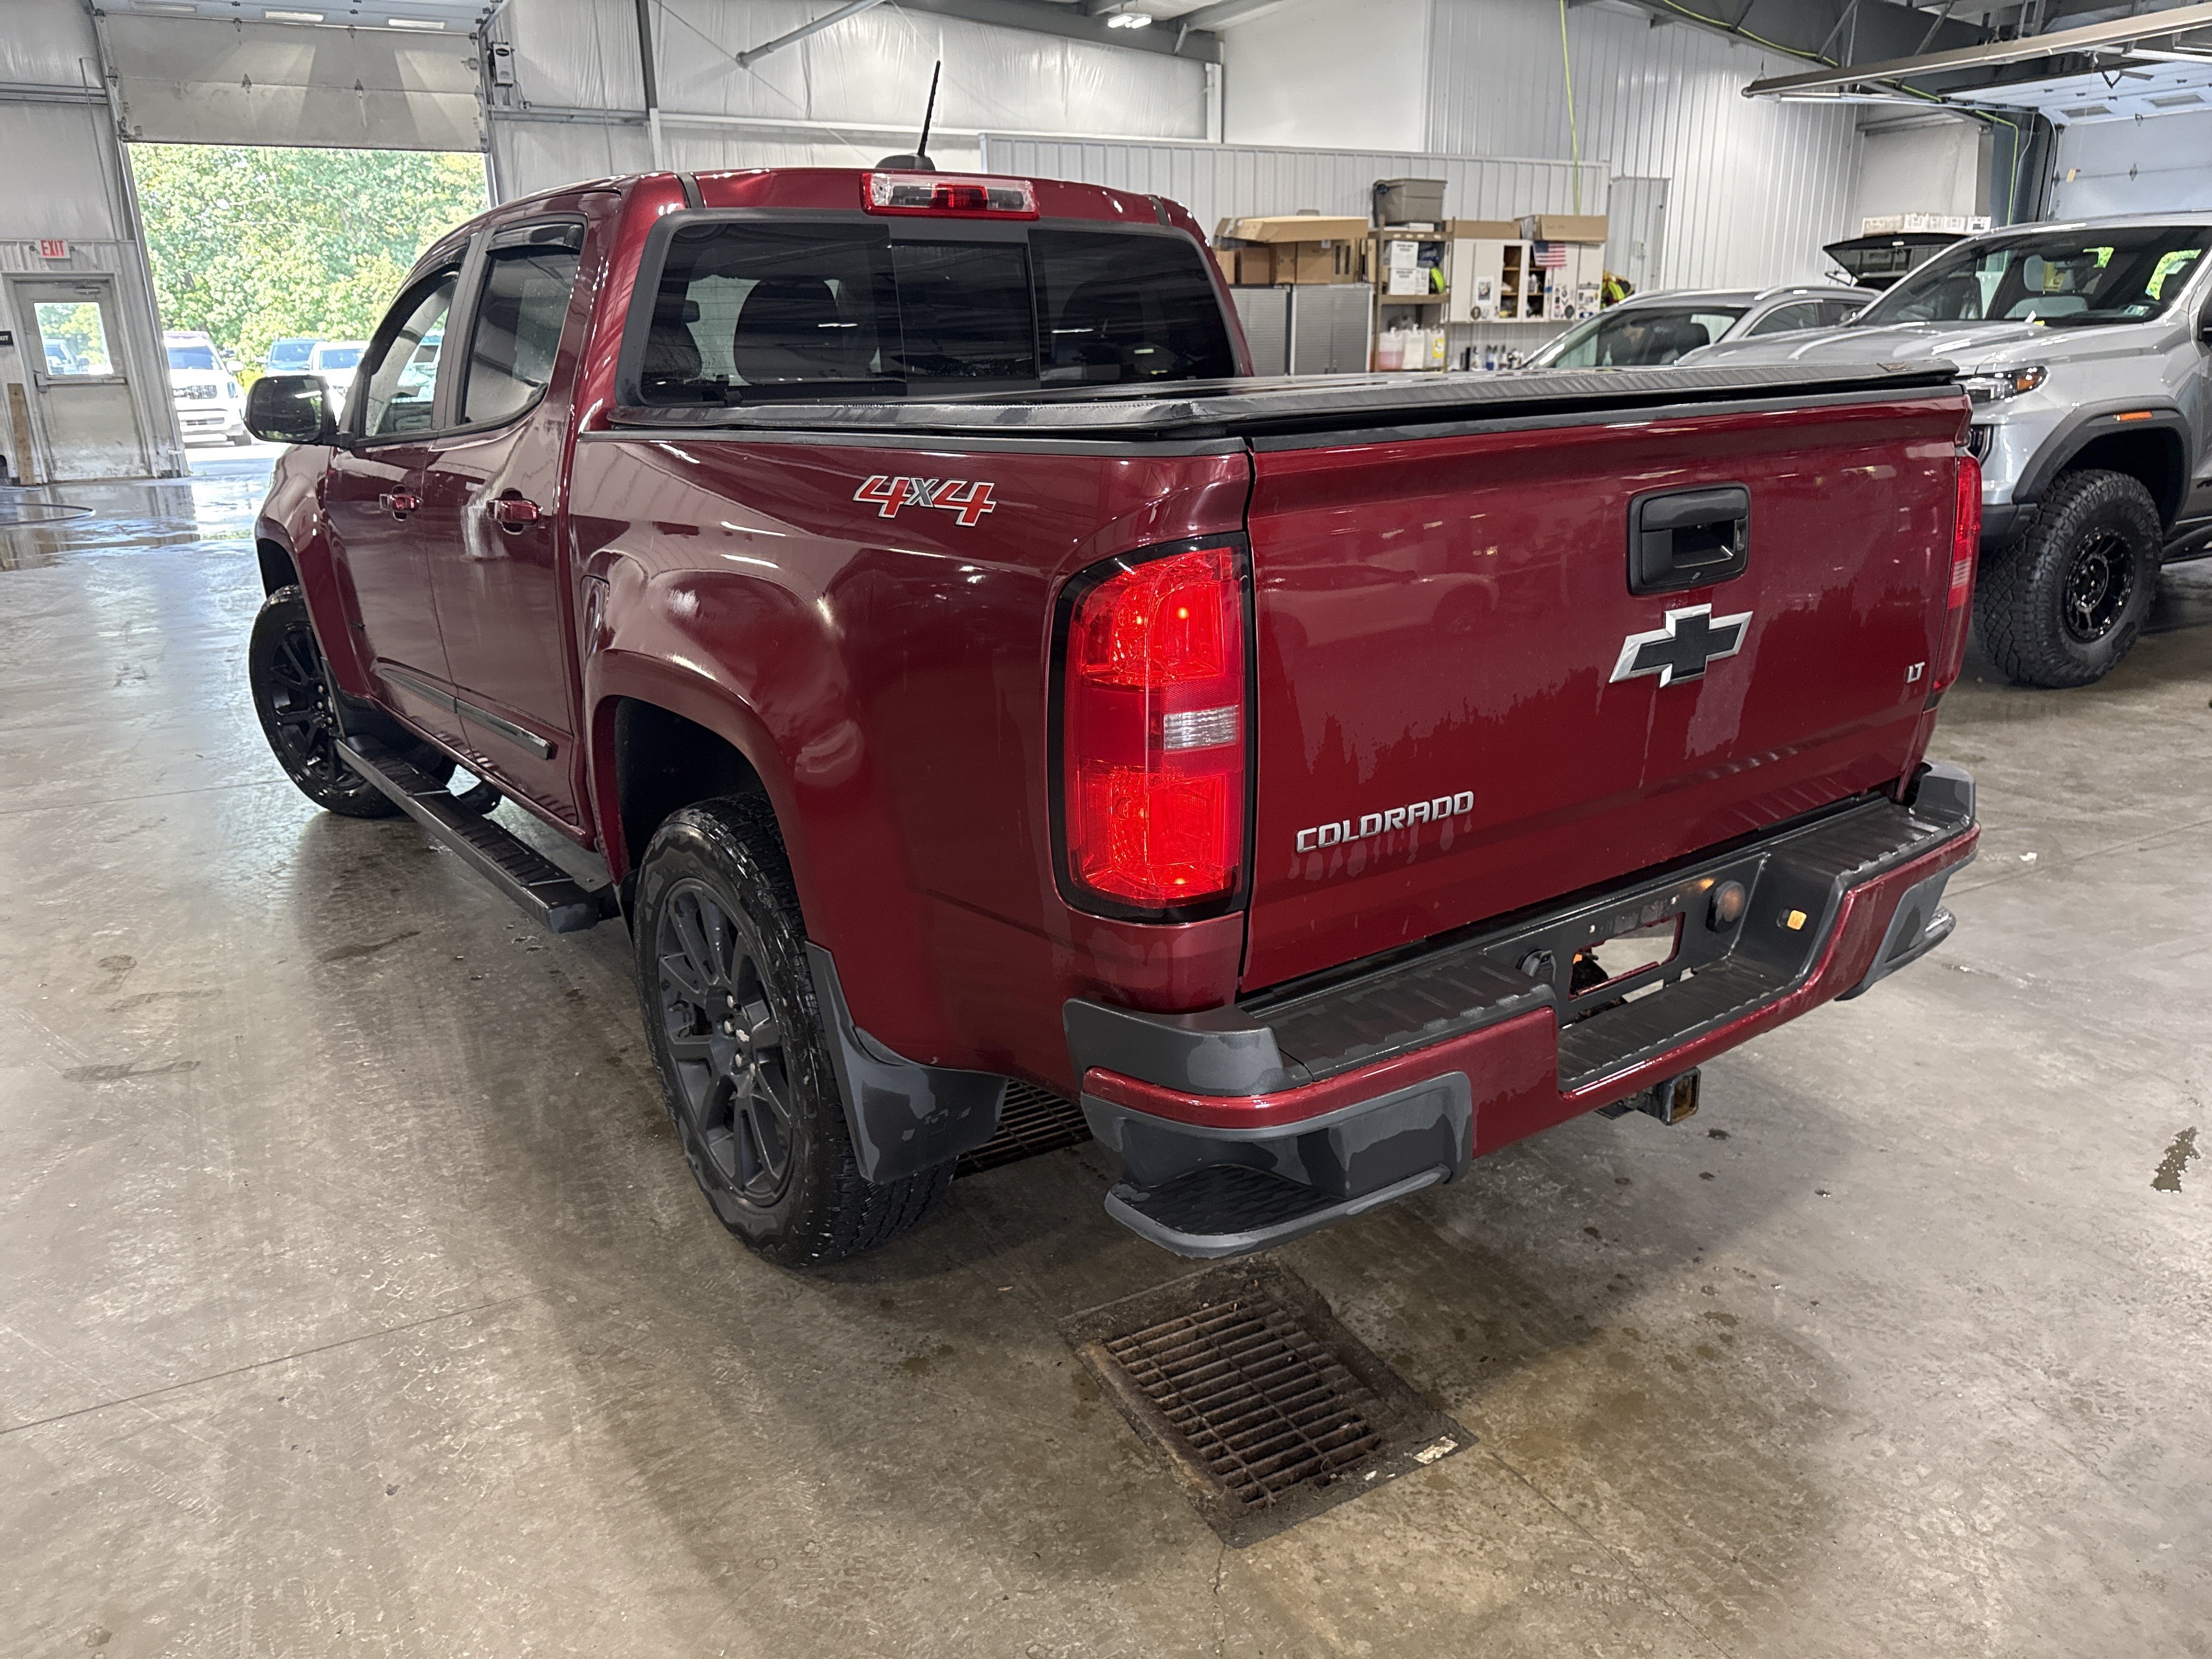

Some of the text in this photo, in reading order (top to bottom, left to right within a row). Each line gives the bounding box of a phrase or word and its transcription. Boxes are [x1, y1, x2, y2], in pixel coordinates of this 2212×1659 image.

[41, 240, 64, 257] EXIT
[1906, 661, 1925, 684] LT
[1296, 791, 1474, 854] COLORADO
